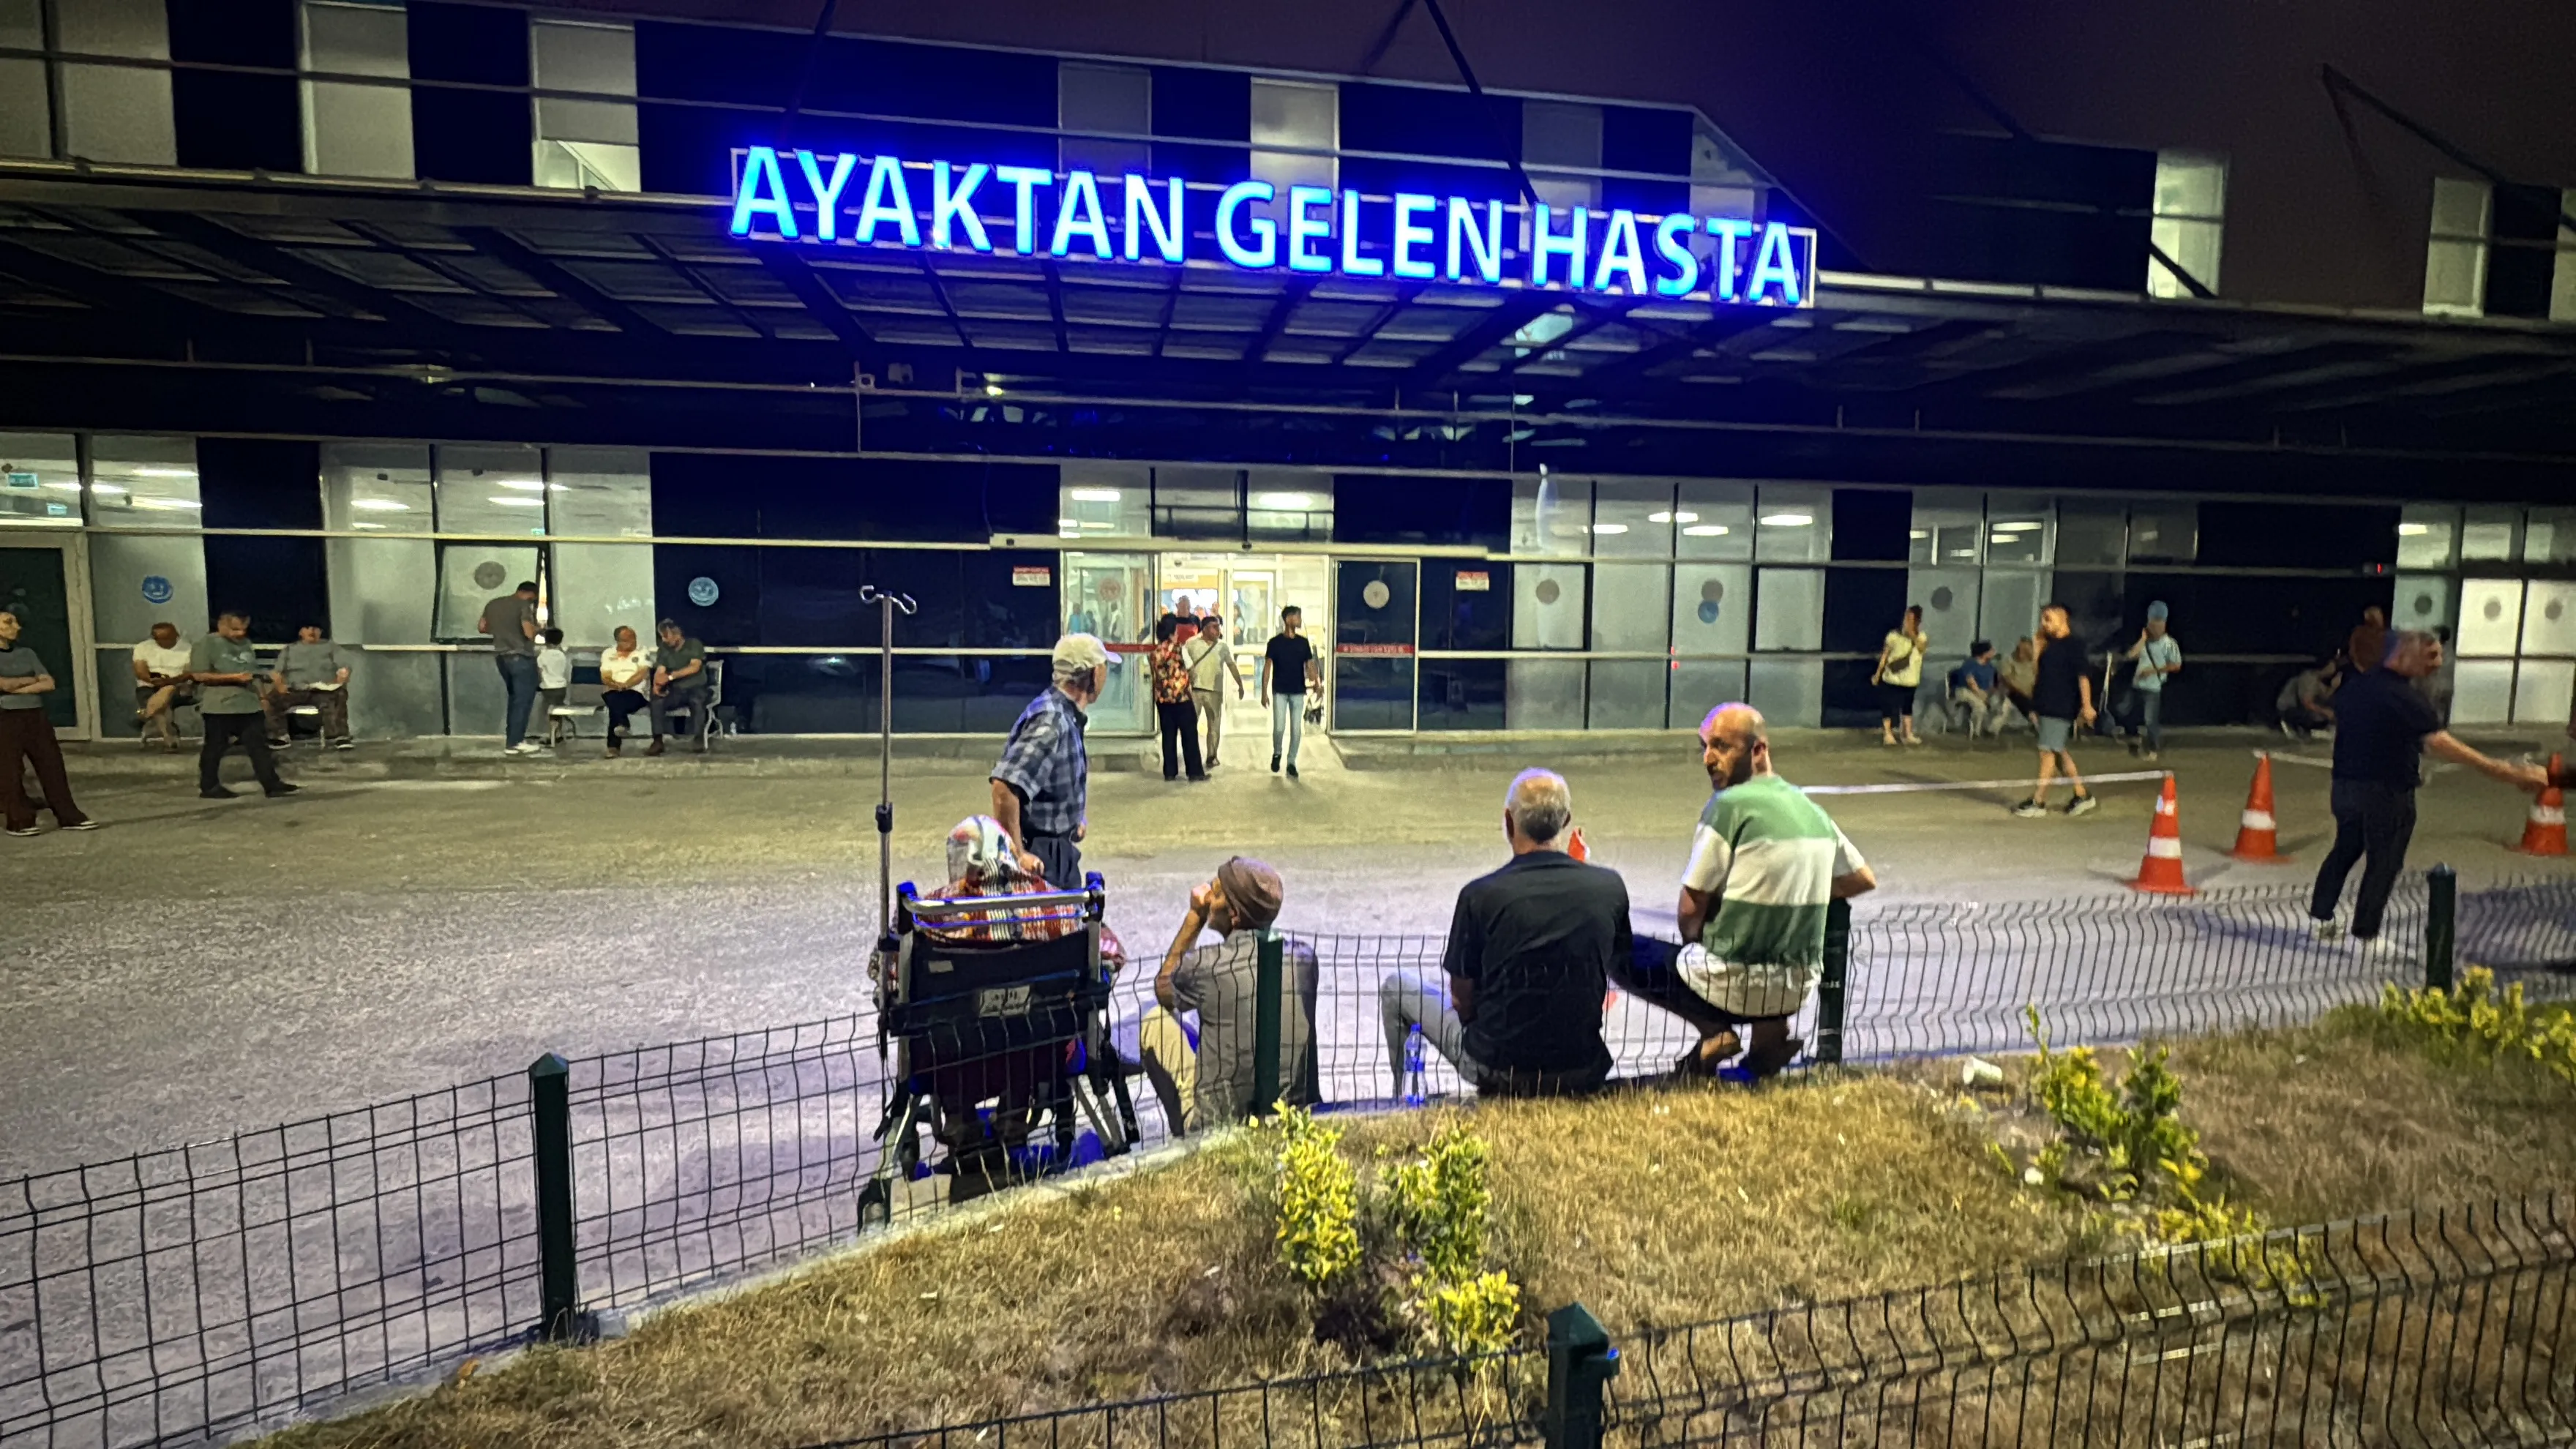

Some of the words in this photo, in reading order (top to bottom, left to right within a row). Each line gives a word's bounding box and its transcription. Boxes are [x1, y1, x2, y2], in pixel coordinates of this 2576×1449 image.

[730, 145, 1185, 263] AYAKTAN
[1215, 180, 1502, 284] GELEN
[1532, 201, 1801, 305] HASTA
